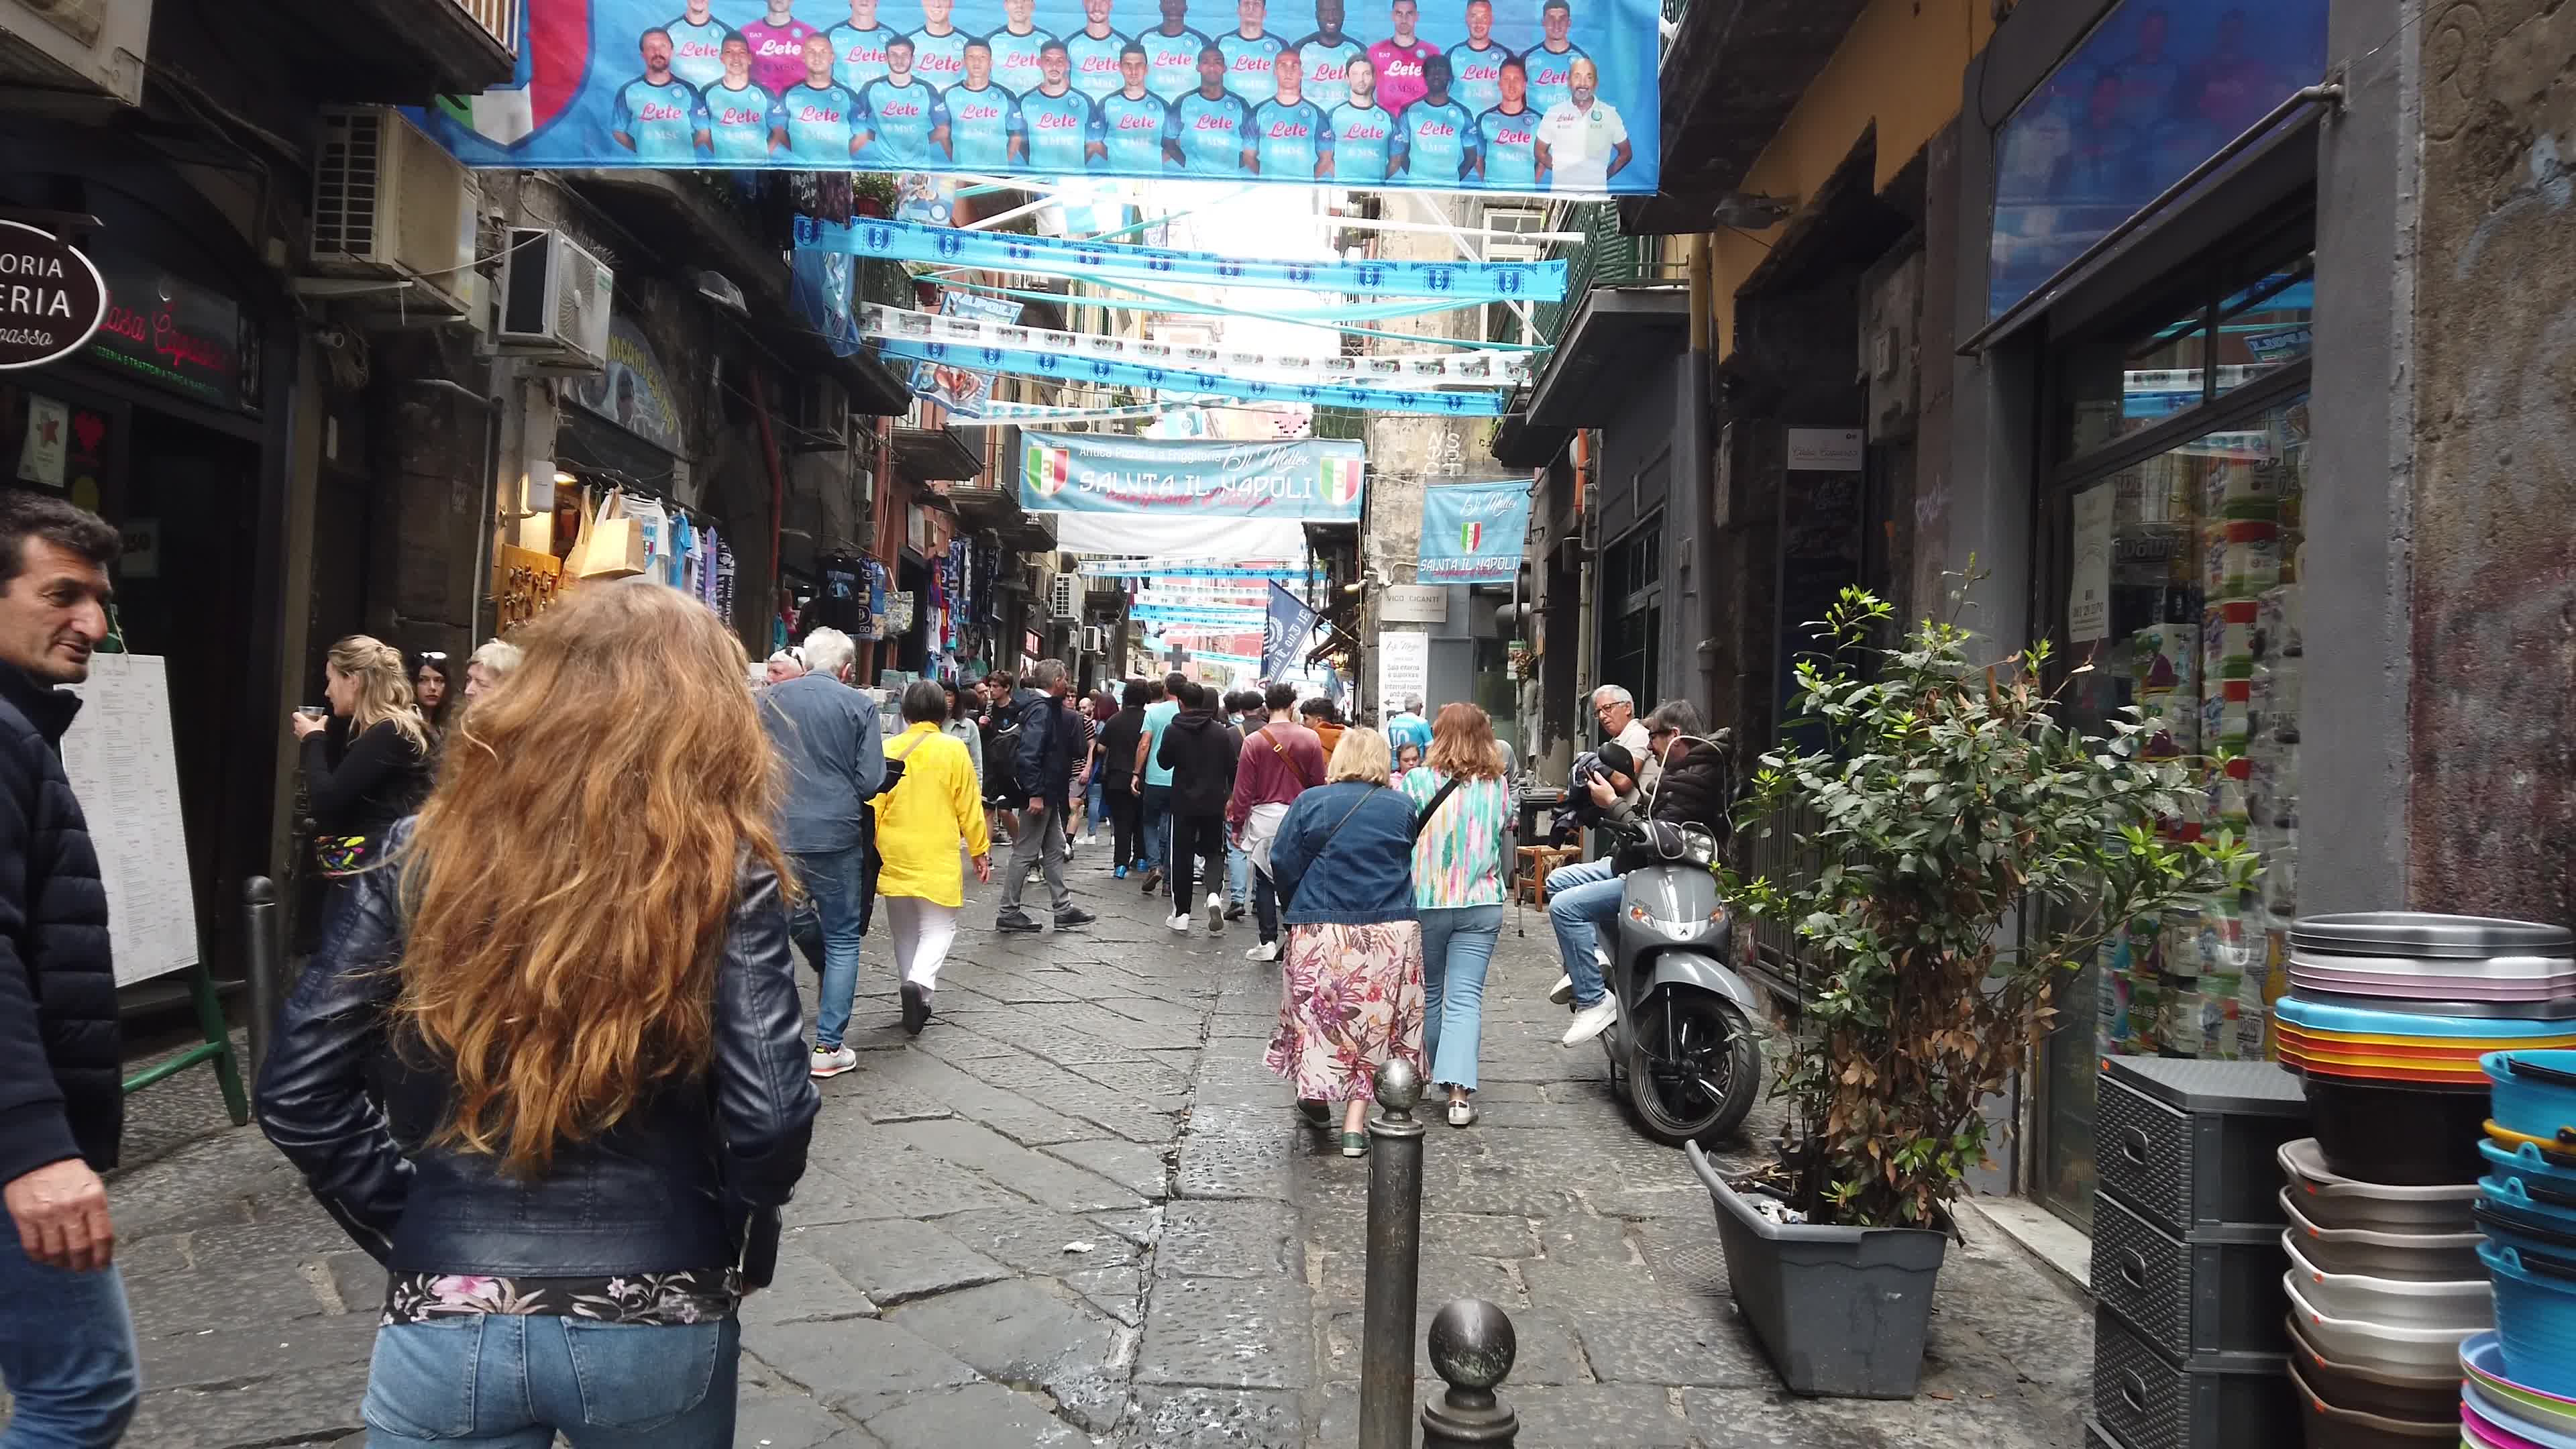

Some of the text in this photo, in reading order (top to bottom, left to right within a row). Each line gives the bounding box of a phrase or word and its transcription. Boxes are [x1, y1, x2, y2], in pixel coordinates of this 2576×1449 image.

[679, 42, 718, 58] Lete
[756, 40, 802, 56] Lete
[845, 46, 887, 62] Lete
[918, 53, 961, 72] Lete
[1080, 56, 1120, 72] Lete
[1155, 50, 1192, 66] Lete
[1232, 55, 1271, 70] Lete
[1312, 64, 1348, 81] Let
[1385, 60, 1423, 76] Lete
[1462, 64, 1497, 80] Lete
[1536, 68, 1567, 85] Let
[639, 103, 682, 121] Lete
[720, 107, 760, 125] Lete
[799, 105, 839, 123] Lete
[881, 101, 918, 116] Lete
[960, 105, 998, 119] Lete
[895, 124, 915, 132] MSC
[1036, 113, 1077, 128] Lete
[1117, 114, 1155, 129] Lete
[1194, 114, 1233, 129] Lete
[1417, 120, 1454, 136] Lete
[1268, 121, 1307, 138] Lete
[1344, 123, 1384, 140] Lete
[1493, 128, 1530, 144] Lete
[1079, 445, 1112, 458] Antica
[1079, 471, 1312, 499] SALUTA IL NAPOLI
[1420, 556, 1517, 572] SALUTA IL NAPOLI
[1392, 729, 1409, 748] 10
